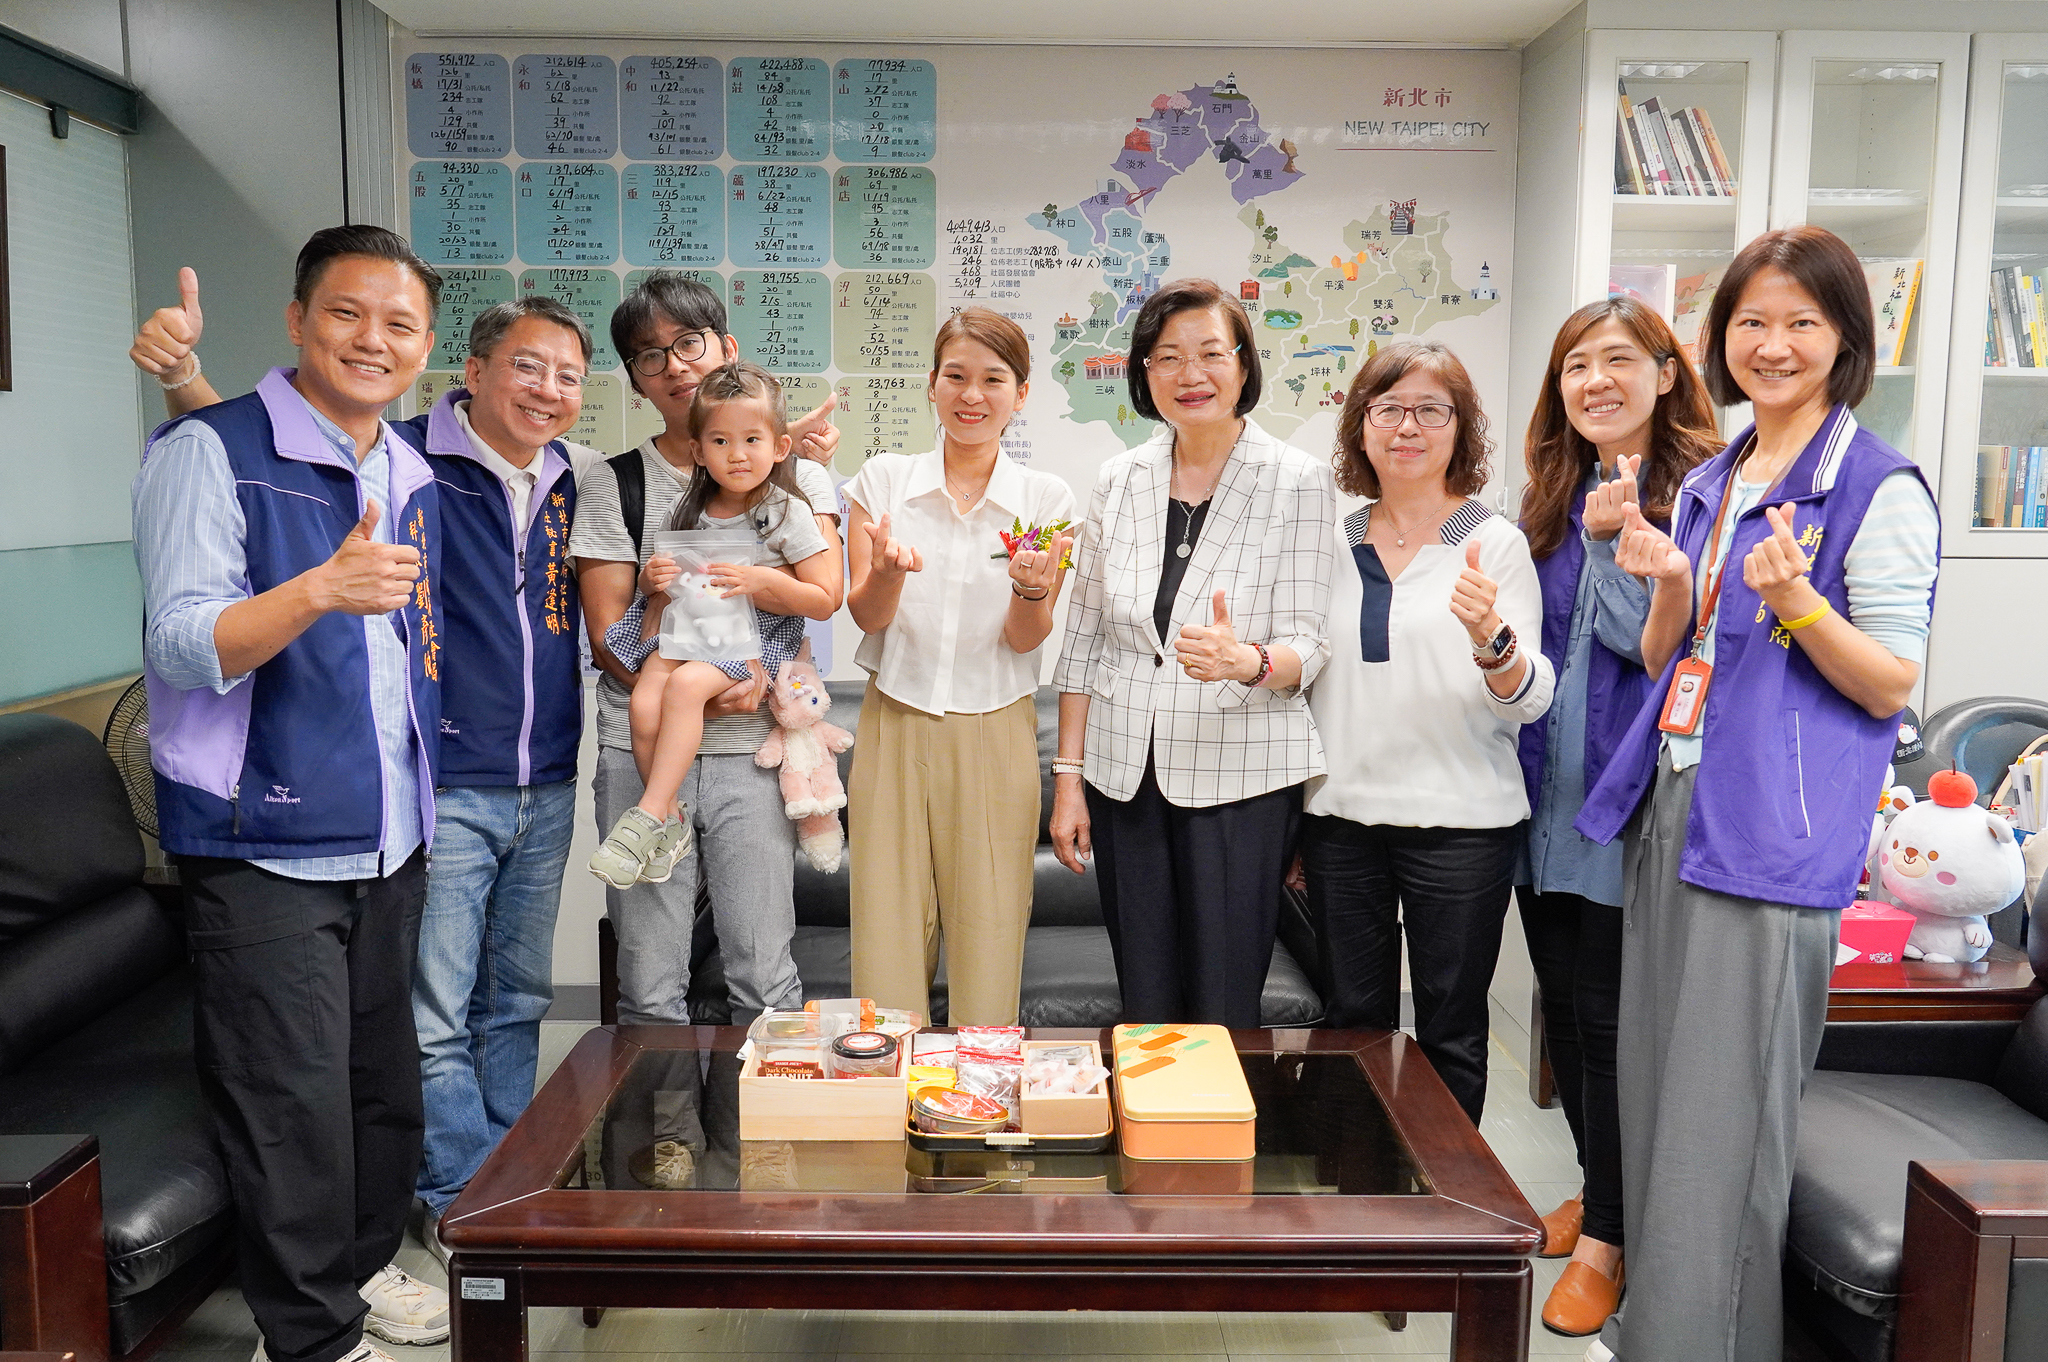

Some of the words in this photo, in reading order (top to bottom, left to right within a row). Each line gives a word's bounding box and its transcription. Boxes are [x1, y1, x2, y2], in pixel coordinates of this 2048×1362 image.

[439, 54, 475, 66] 551,972
[546, 56, 586, 68] 212,614
[651, 57, 698, 69] 405,254
[760, 58, 804, 70] 422,488
[411, 63, 423, 89] 板橋
[519, 64, 530, 90] 永和
[626, 66, 636, 92] 中和
[732, 67, 743, 93] 新莊
[764, 72, 778, 80] 84
[839, 68, 849, 94] 泰山
[442, 92, 464, 102] 234
[551, 92, 563, 103] 62
[658, 94, 670, 105] 92
[761, 95, 777, 105] 108
[869, 96, 881, 107] 37
[1383, 88, 1452, 108] 新北市
[1212, 104, 1232, 113] 石門
[444, 116, 462, 127] 129
[554, 117, 565, 128] 39
[764, 120, 777, 130] 42
[870, 122, 883, 131] 20
[1171, 127, 1191, 136] 三芝
[1345, 121, 1384, 135] NEW
[1391, 121, 1443, 136] TAIPEI
[1452, 122, 1490, 136] CITY
[1239, 134, 1260, 143] 金山
[445, 141, 457, 151] 90
[548, 142, 564, 153] 46
[765, 145, 778, 155] 32
[1126, 159, 1146, 169] 淡水
[549, 164, 594, 176] 137,604
[654, 164, 698, 177] 383,292
[758, 166, 798, 177] 197,230
[868, 167, 908, 178] 306,986
[1252, 169, 1273, 179] 萬里
[415, 171, 426, 197] 五股
[521, 172, 532, 197] 林口
[554, 176, 565, 186] 17
[627, 173, 638, 199] 三重
[656, 177, 671, 187] 119
[765, 179, 776, 188] 38
[869, 180, 881, 190] 69
[733, 174, 744, 200] 蘆洲
[839, 176, 850, 201] 新店
[447, 199, 460, 209] 35
[552, 200, 564, 210] 41
[659, 200, 671, 211] 93
[1089, 196, 1109, 205] 八里
[764, 202, 778, 213] 48
[872, 203, 883, 213] 95
[447, 222, 460, 232] 30
[947, 219, 990, 234] 4,049,413
[1056, 219, 1075, 228] 林口
[657, 225, 675, 236] 129
[764, 227, 775, 236] 51
[870, 227, 883, 238] 56
[1112, 228, 1132, 238] 五股
[1361, 231, 1381, 240] 瑞芳
[954, 234, 982, 244] 1,032
[1144, 233, 1165, 243] 蘆洲
[660, 248, 674, 260] 63
[952, 246, 983, 256] 190,181
[765, 253, 779, 261] 26
[870, 253, 882, 261] 36
[962, 256, 981, 265] 246
[991, 258, 1028, 266] 位佈老志工
[1102, 257, 1122, 266] 泰山
[1149, 256, 1170, 266] 三重
[1252, 254, 1272, 263] 汐止
[550, 269, 588, 282] 177,973
[961, 265, 980, 276] 468
[448, 270, 486, 283] 241,211
[763, 272, 800, 284] 89,755
[866, 273, 909, 285] 212,669
[449, 283, 461, 291] 47
[554, 283, 567, 291] 42
[955, 277, 981, 288] 5,209
[1113, 279, 1133, 288] 新莊
[1324, 281, 1344, 291] 平溪
[524, 278, 535, 299] 樹
[734, 281, 745, 306] 鶯歌
[869, 286, 880, 294] 50
[839, 281, 850, 307] 汐止
[963, 290, 976, 298] 14
[1126, 295, 1146, 304] 板橋
[1373, 299, 1393, 309] 雙溪
[1441, 295, 1461, 305] 貢寮
[767, 309, 780, 318] 43
[1089, 319, 1109, 328] 樹林
[453, 330, 463, 338] 61
[767, 331, 780, 343] 27
[870, 333, 885, 343] 52
[1059, 330, 1079, 339] 鶯歌
[1122, 331, 1130, 339] 土
[1258, 350, 1271, 359] 碇
[768, 356, 778, 366] 13
[1311, 367, 1331, 376] 坪林
[868, 378, 904, 389] 23,763
[422, 382, 433, 408] 瑞芳
[1095, 385, 1115, 395] 三峽
[840, 387, 850, 411] 深坑
